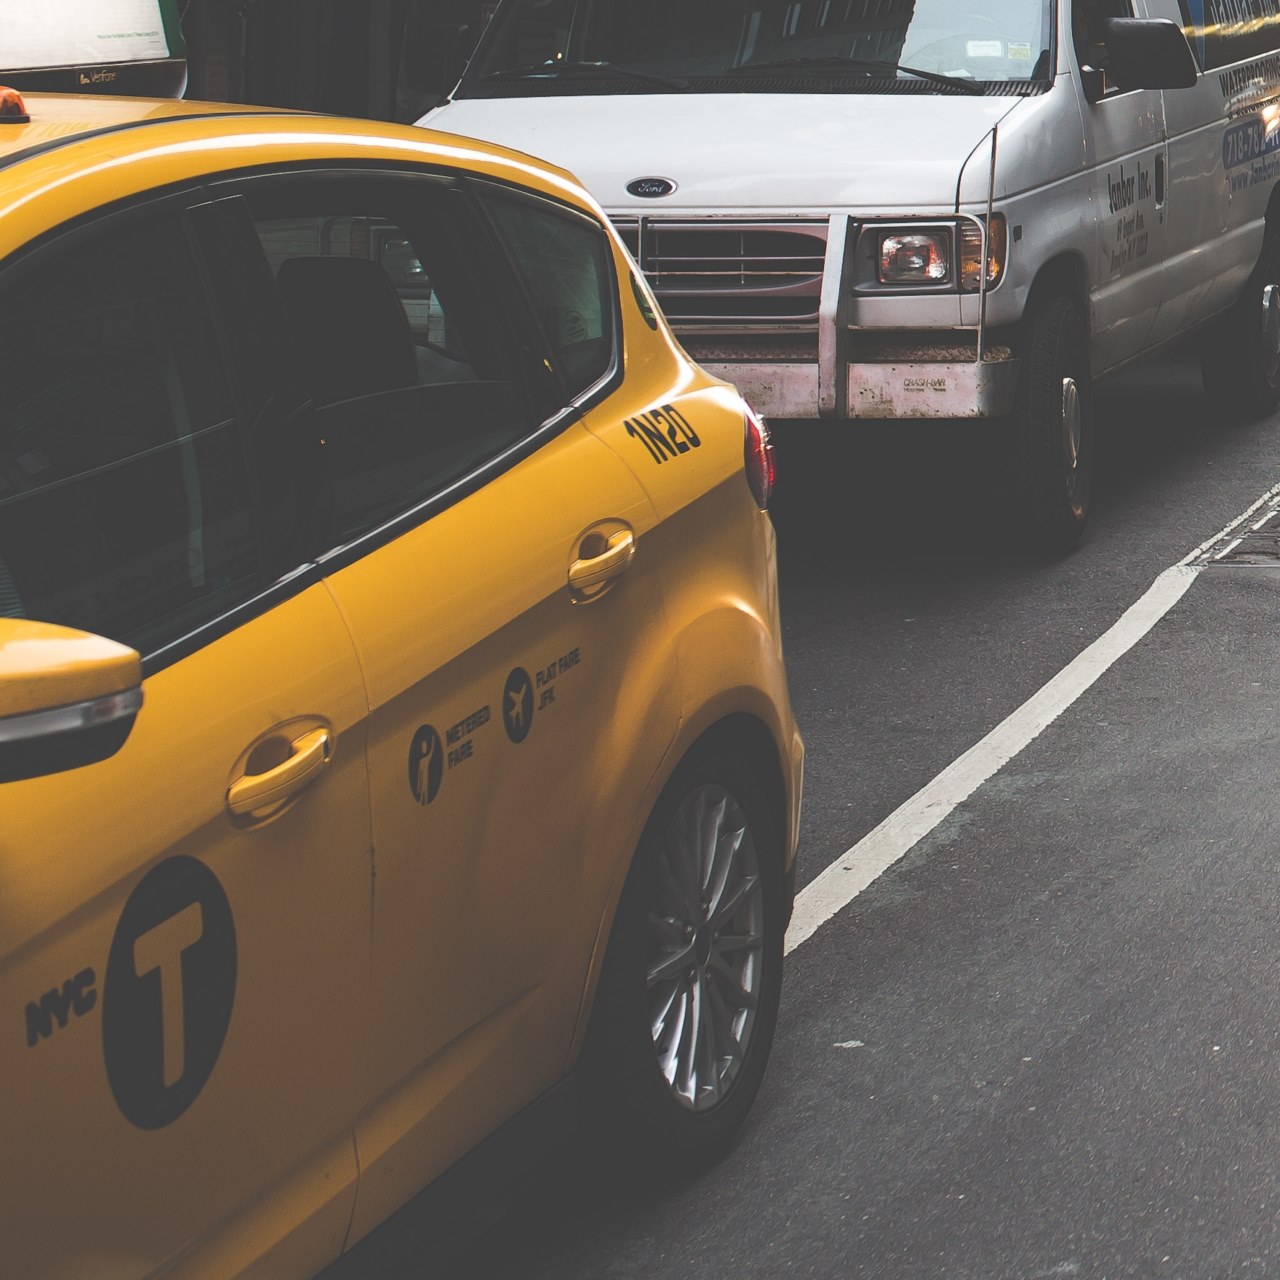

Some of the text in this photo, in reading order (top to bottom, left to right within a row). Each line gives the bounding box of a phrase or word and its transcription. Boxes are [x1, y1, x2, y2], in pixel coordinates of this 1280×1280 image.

[636, 181, 665, 195] Ford
[1107, 164, 1135, 215] Janbar
[622, 403, 703, 466] 1N20
[535, 647, 582, 689] FLAT FARE
[537, 686, 556, 711] JFK
[446, 704, 491, 747] METERED
[447, 739, 475, 770] FARE
[25, 902, 205, 1089] NYC T
